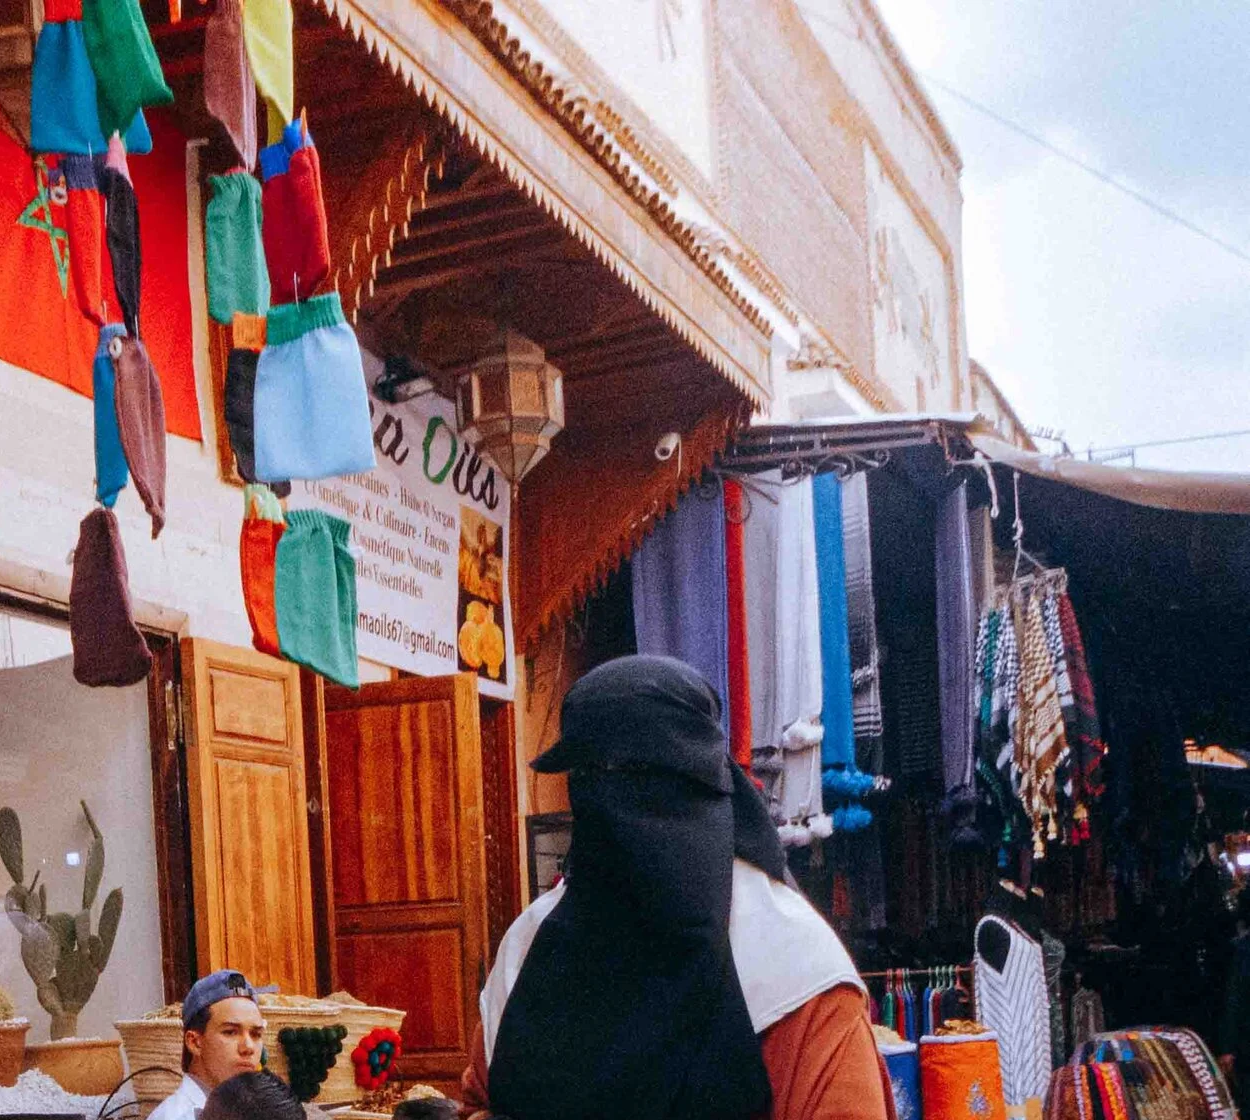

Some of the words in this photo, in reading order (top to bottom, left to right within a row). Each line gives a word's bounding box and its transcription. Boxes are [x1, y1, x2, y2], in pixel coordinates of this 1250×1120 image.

[422, 415, 499, 511] Oils
[362, 498, 372, 522] &
[376, 503, 417, 539] Culinaire
[352, 524, 406, 566] Cosmétique
[406, 547, 444, 579] Naturelle
[373, 563, 424, 600] Essentielles
[356, 611, 456, 661] maoils67@gmail.com
